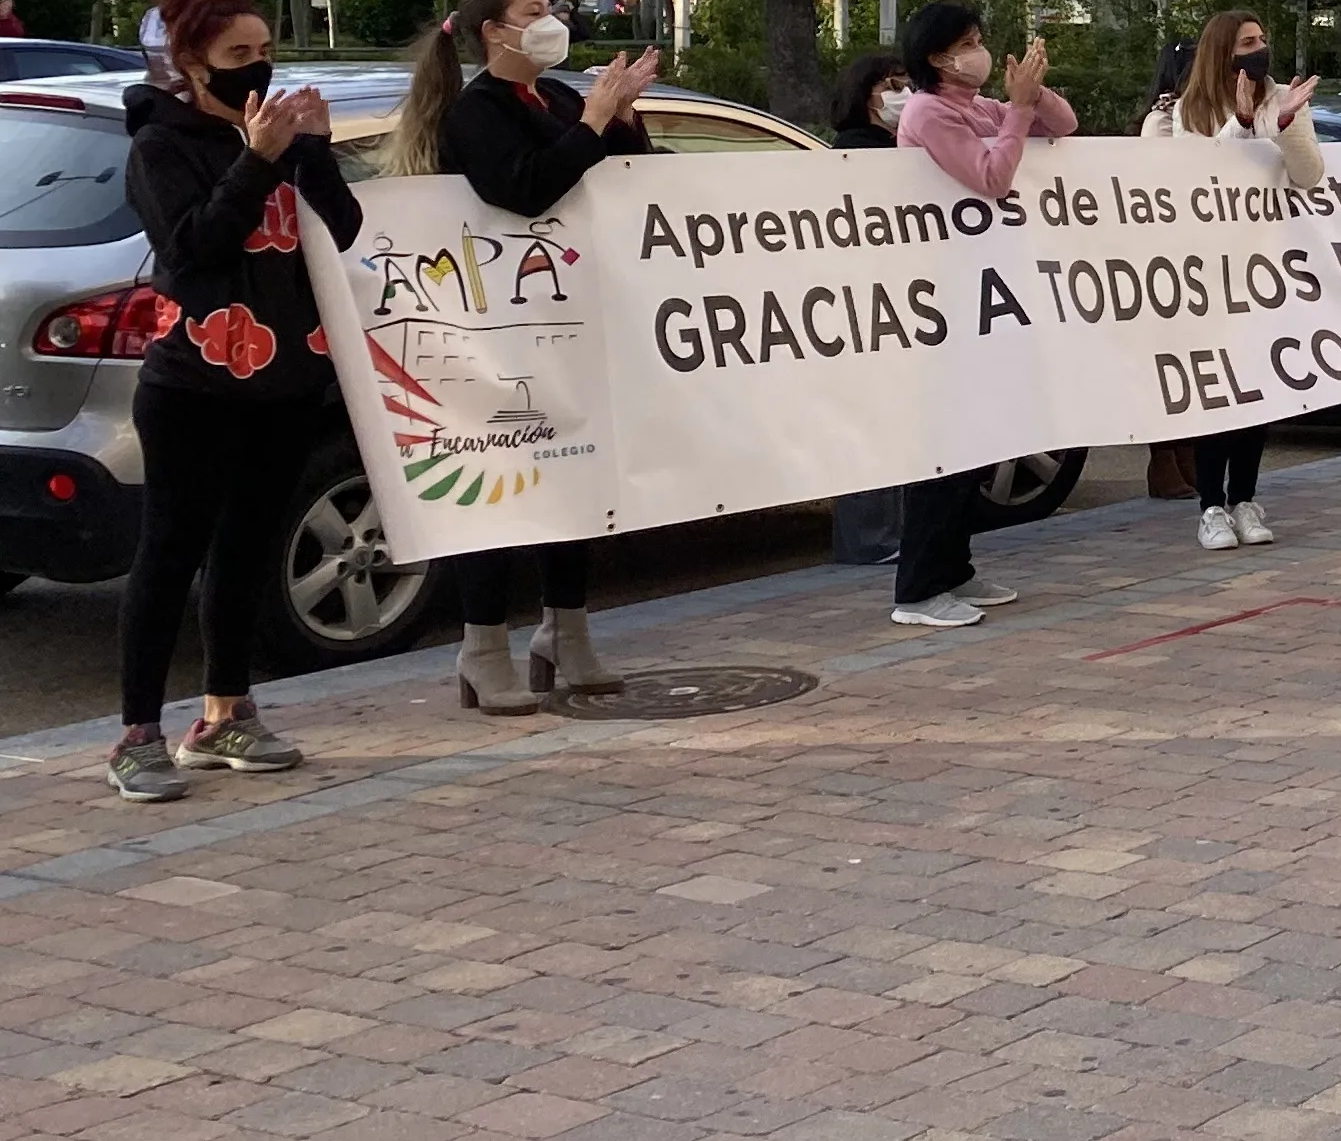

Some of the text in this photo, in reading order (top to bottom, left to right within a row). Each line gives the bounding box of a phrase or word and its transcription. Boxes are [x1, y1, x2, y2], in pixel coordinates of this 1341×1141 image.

[640, 190, 1027, 269] Aprendamos
[1040, 176, 1098, 226] de
[1111, 176, 1177, 225] las
[372, 219, 573, 316] AMPA
[655, 278, 948, 372] GRACIAS
[978, 267, 1032, 336] A
[1037, 254, 1209, 324] TODOS
[1221, 248, 1322, 314] LOS
[1154, 347, 1264, 415] DEL
[429, 420, 558, 459] Encarnación
[533, 444, 596, 460] COLEGIO
